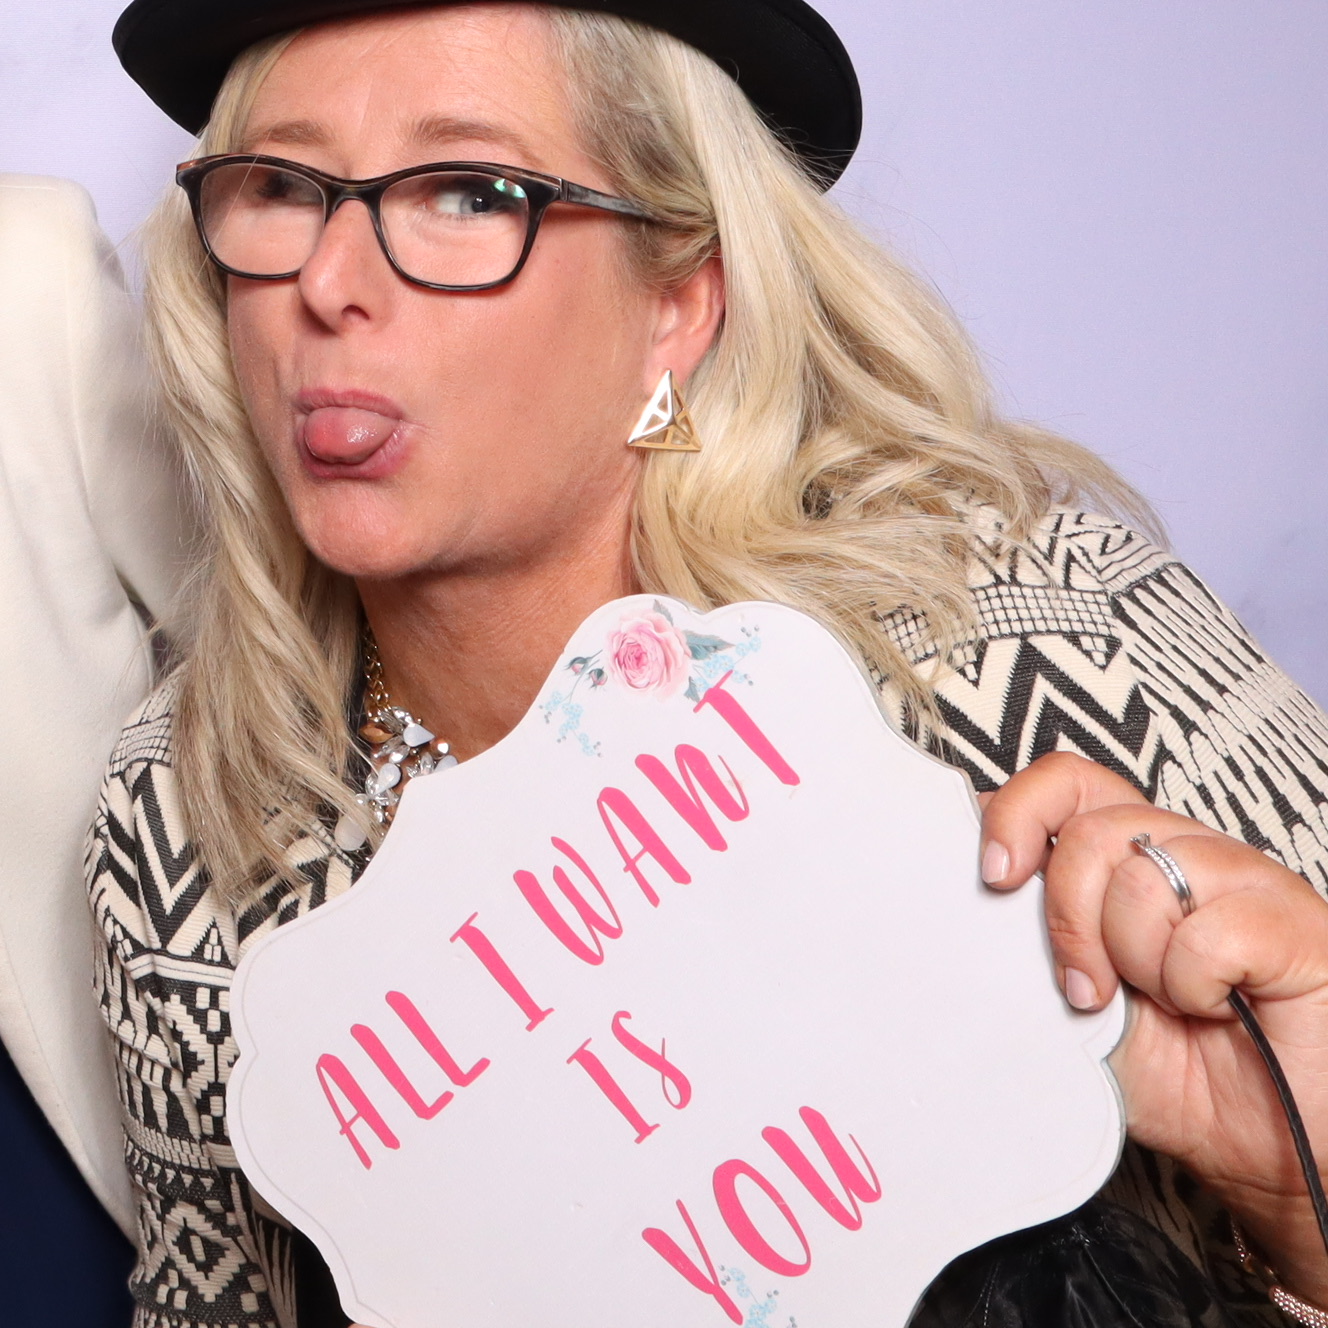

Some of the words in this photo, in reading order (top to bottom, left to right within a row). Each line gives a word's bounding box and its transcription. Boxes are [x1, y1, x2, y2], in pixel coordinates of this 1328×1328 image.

[316, 989, 492, 1170] ALL
[449, 911, 556, 1033] I
[512, 671, 802, 967] WANT
[566, 1009, 693, 1145] IS
[641, 1104, 883, 1326] YOU
